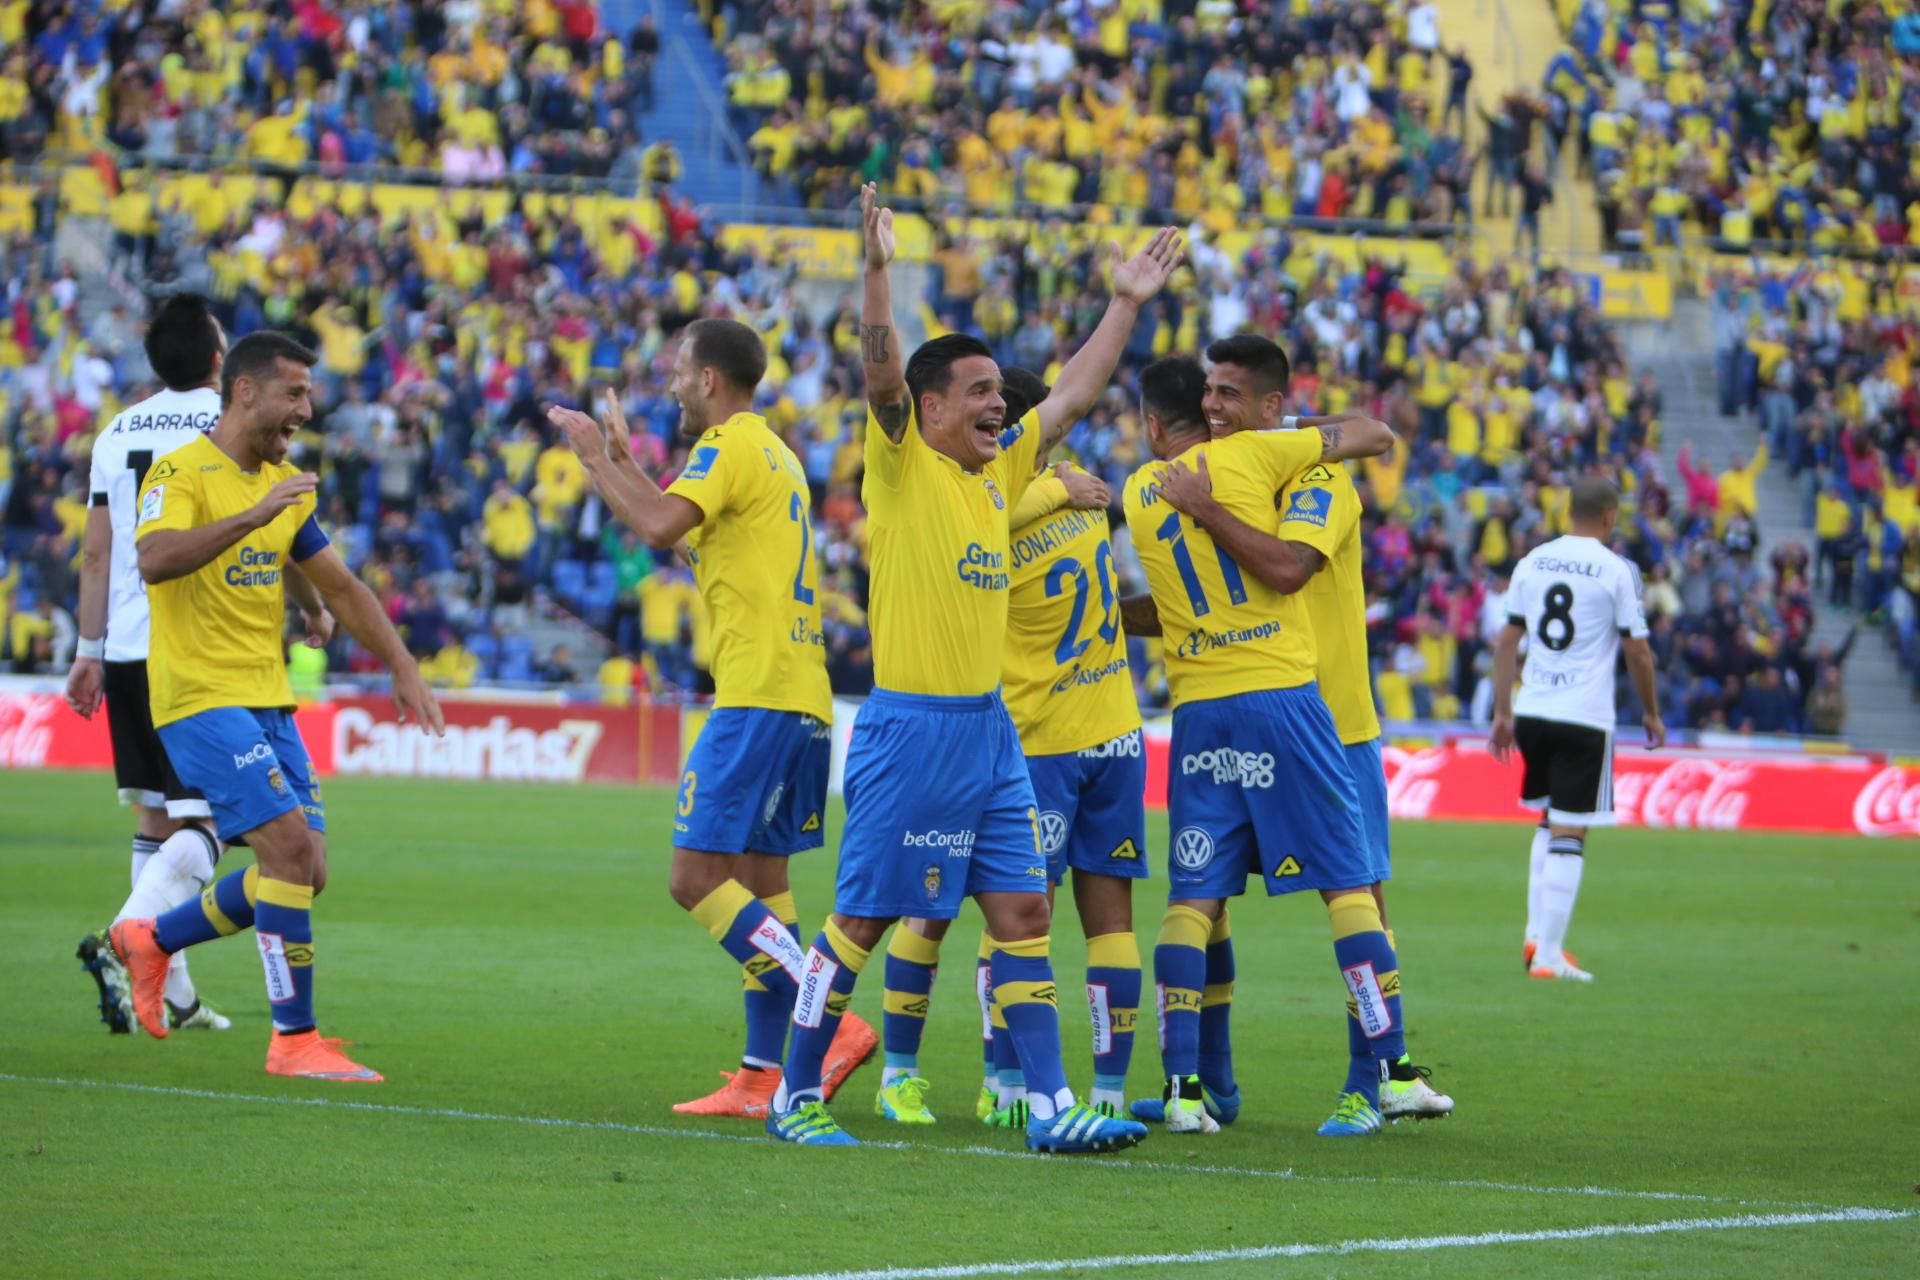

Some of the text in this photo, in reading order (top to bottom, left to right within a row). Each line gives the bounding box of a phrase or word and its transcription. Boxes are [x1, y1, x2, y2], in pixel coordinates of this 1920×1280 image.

[128, 412, 220, 432] BARRAGA
[1009, 510, 1090, 568] JONATHAN
[1156, 511, 1248, 617] 11
[1537, 582, 1575, 651] 8
[333, 705, 603, 786] Canarias7
[678, 771, 697, 817] 3
[760, 926, 778, 944] EA
[266, 953, 284, 998] SPORTS
[798, 954, 824, 1024] EA SPORTS
[1357, 986, 1380, 1033] SPORTS
